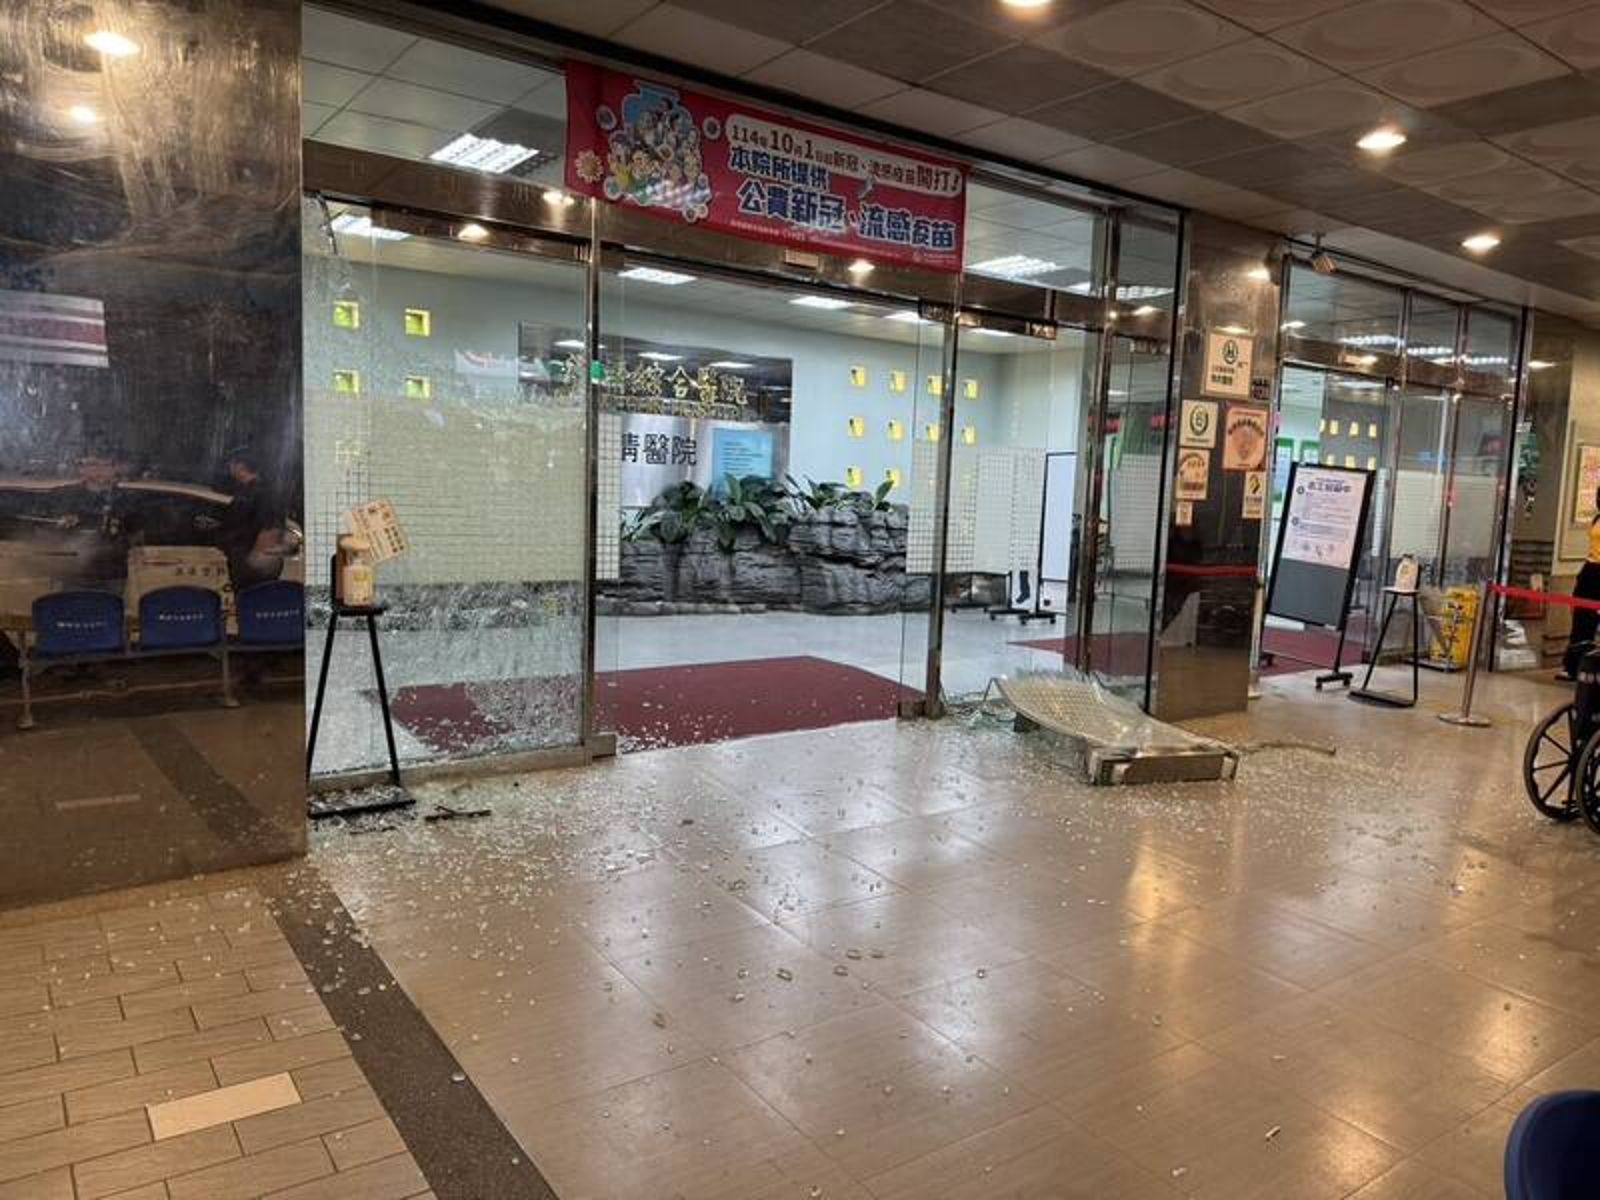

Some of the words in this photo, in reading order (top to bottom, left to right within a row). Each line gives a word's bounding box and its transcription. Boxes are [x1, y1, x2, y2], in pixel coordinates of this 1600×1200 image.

[738, 180, 955, 249] 公費新冠、流感疫苗
